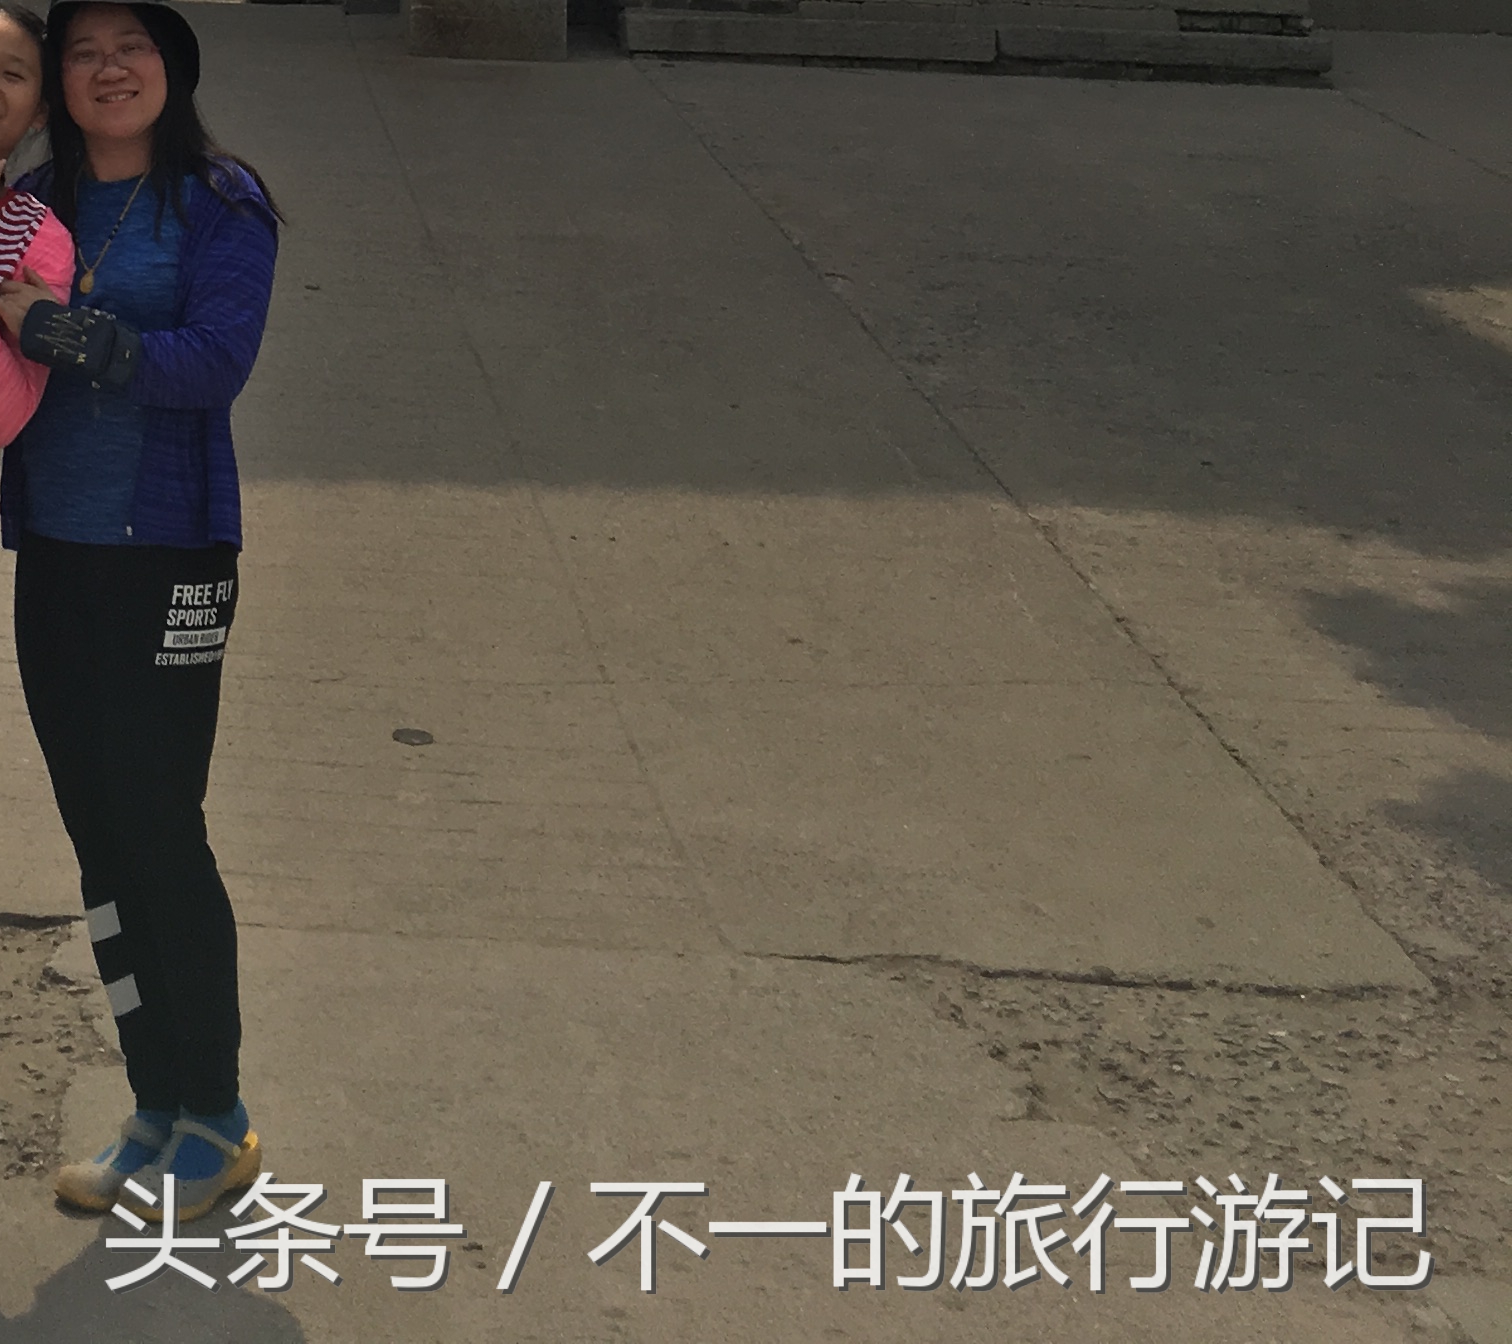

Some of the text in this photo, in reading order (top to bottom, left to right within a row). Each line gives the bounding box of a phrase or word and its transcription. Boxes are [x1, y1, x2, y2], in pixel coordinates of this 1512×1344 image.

[171, 579, 234, 606] FREE FLY
[166, 607, 218, 627] SPORTS
